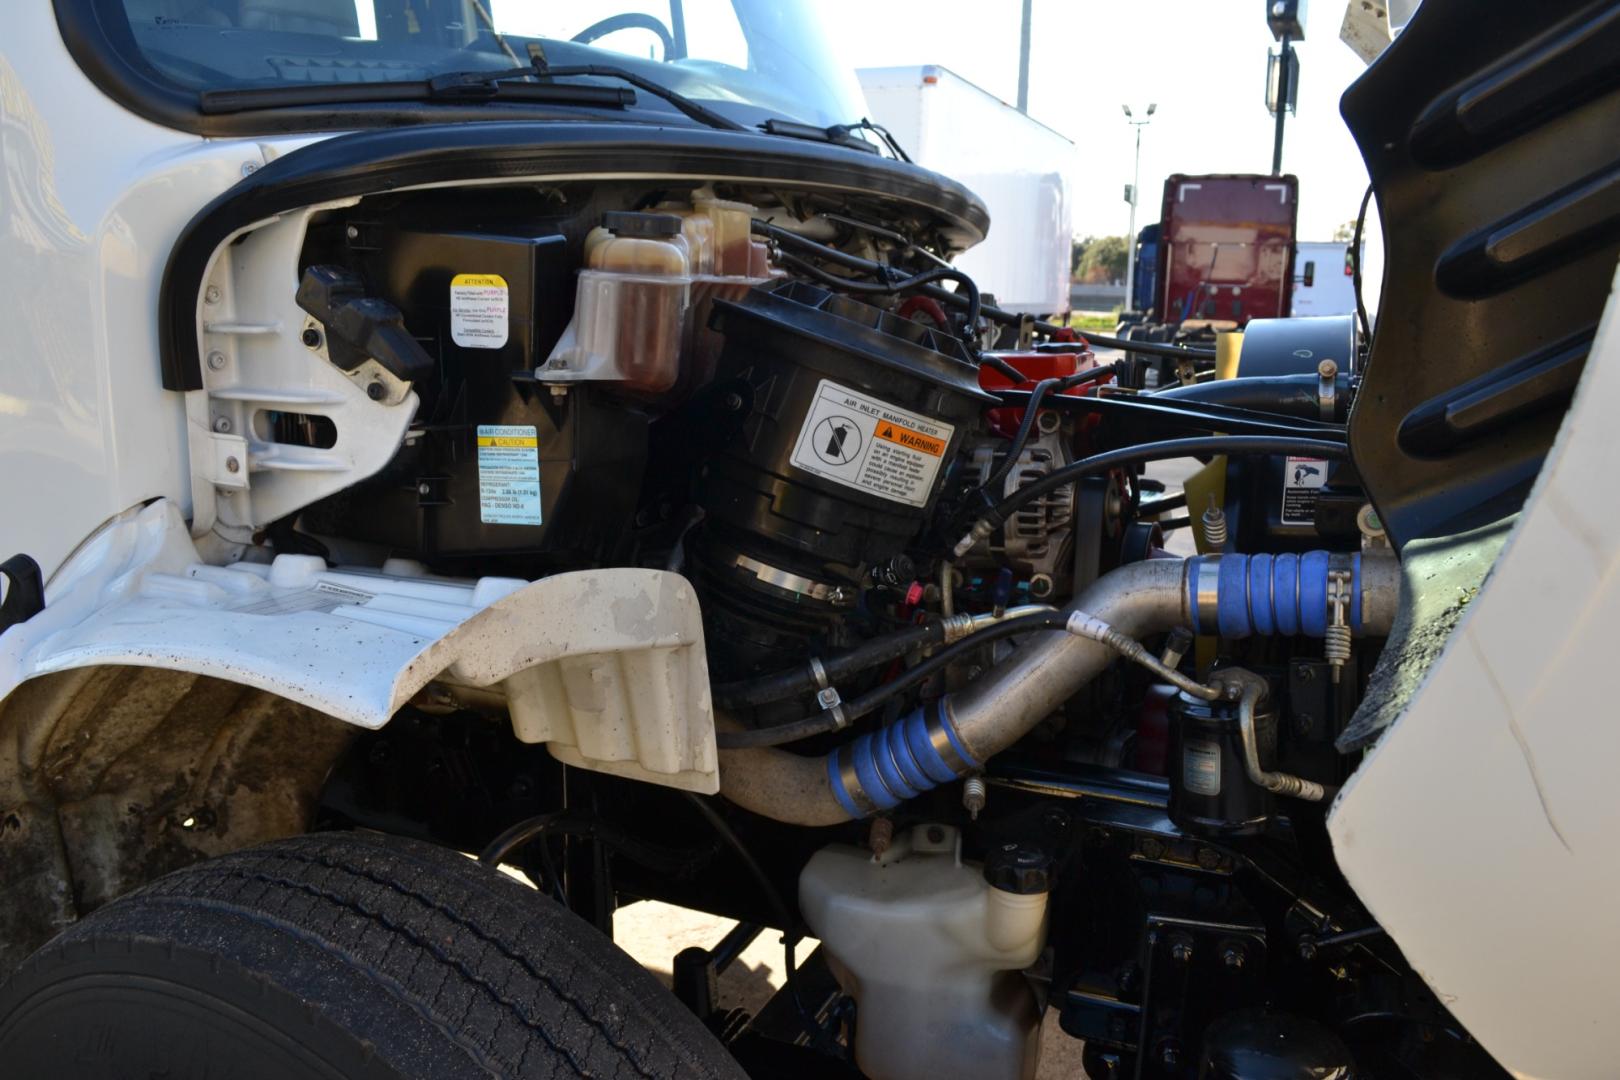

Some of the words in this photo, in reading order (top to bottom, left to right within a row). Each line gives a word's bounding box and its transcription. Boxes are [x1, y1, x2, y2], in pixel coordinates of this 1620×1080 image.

[844, 398, 857, 407] AIR
[860, 404, 881, 416] INLET
[882, 412, 916, 428] MANIFOLD
[917, 424, 938, 435] HEATER
[900, 433, 940, 453] WARNING
